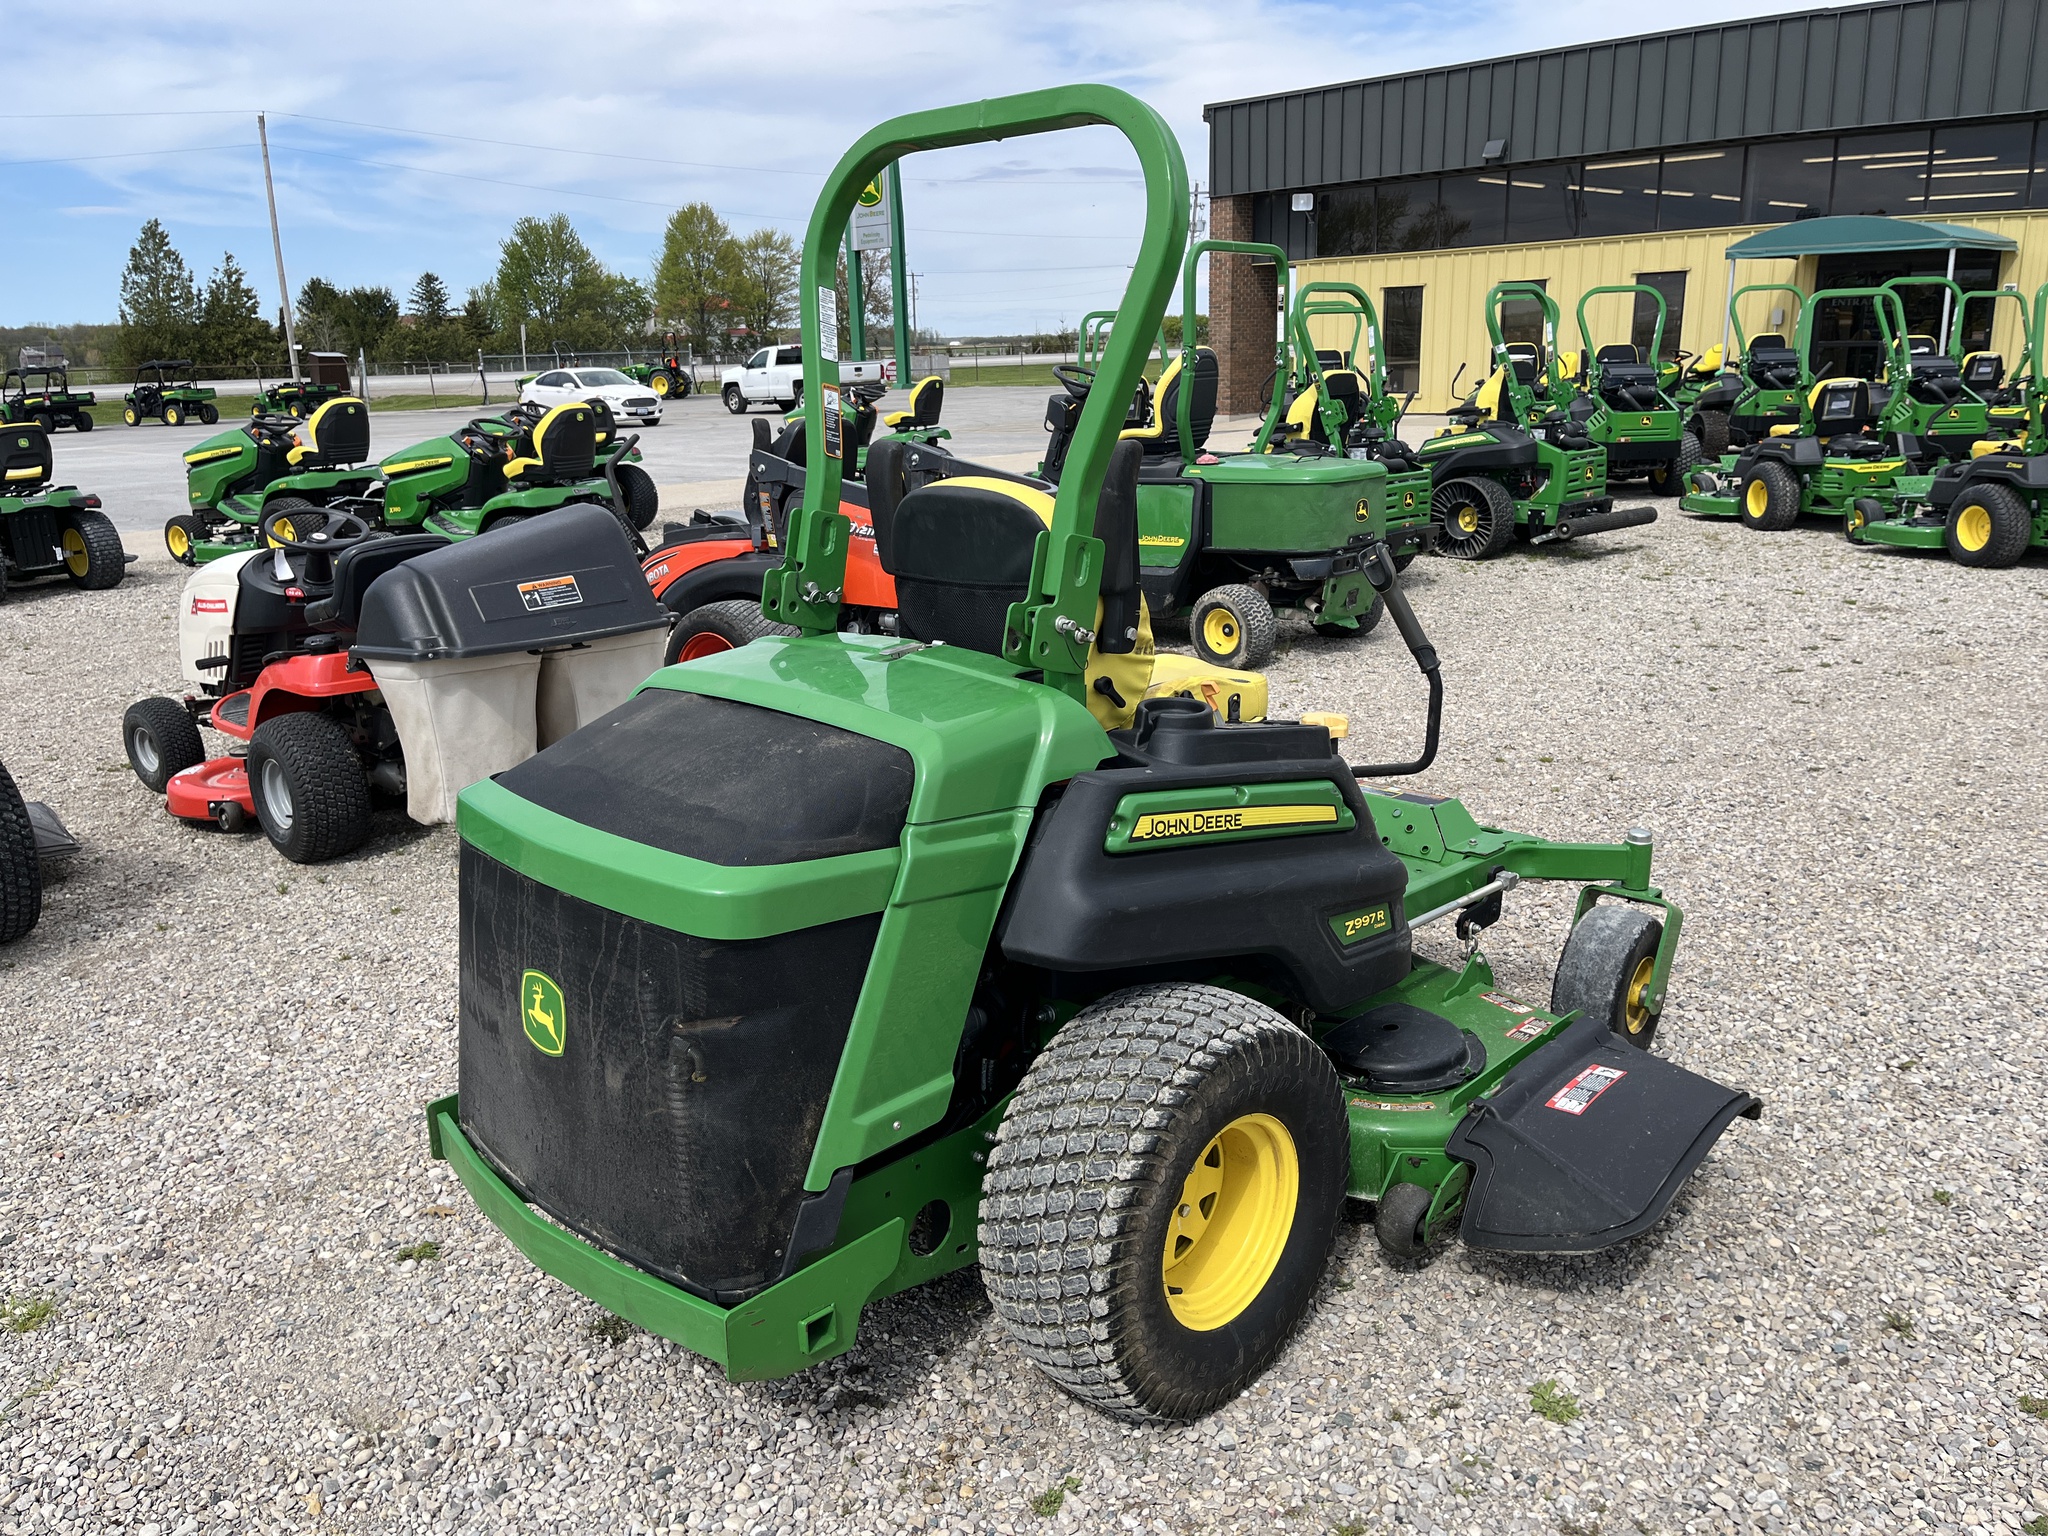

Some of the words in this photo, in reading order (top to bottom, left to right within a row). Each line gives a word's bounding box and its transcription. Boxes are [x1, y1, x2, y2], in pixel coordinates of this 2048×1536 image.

[1141, 535, 1158, 543] JOHN
[1158, 535, 1180, 544] DEERE
[1149, 818, 1190, 837] JOHN
[1193, 813, 1243, 831] DEERE
